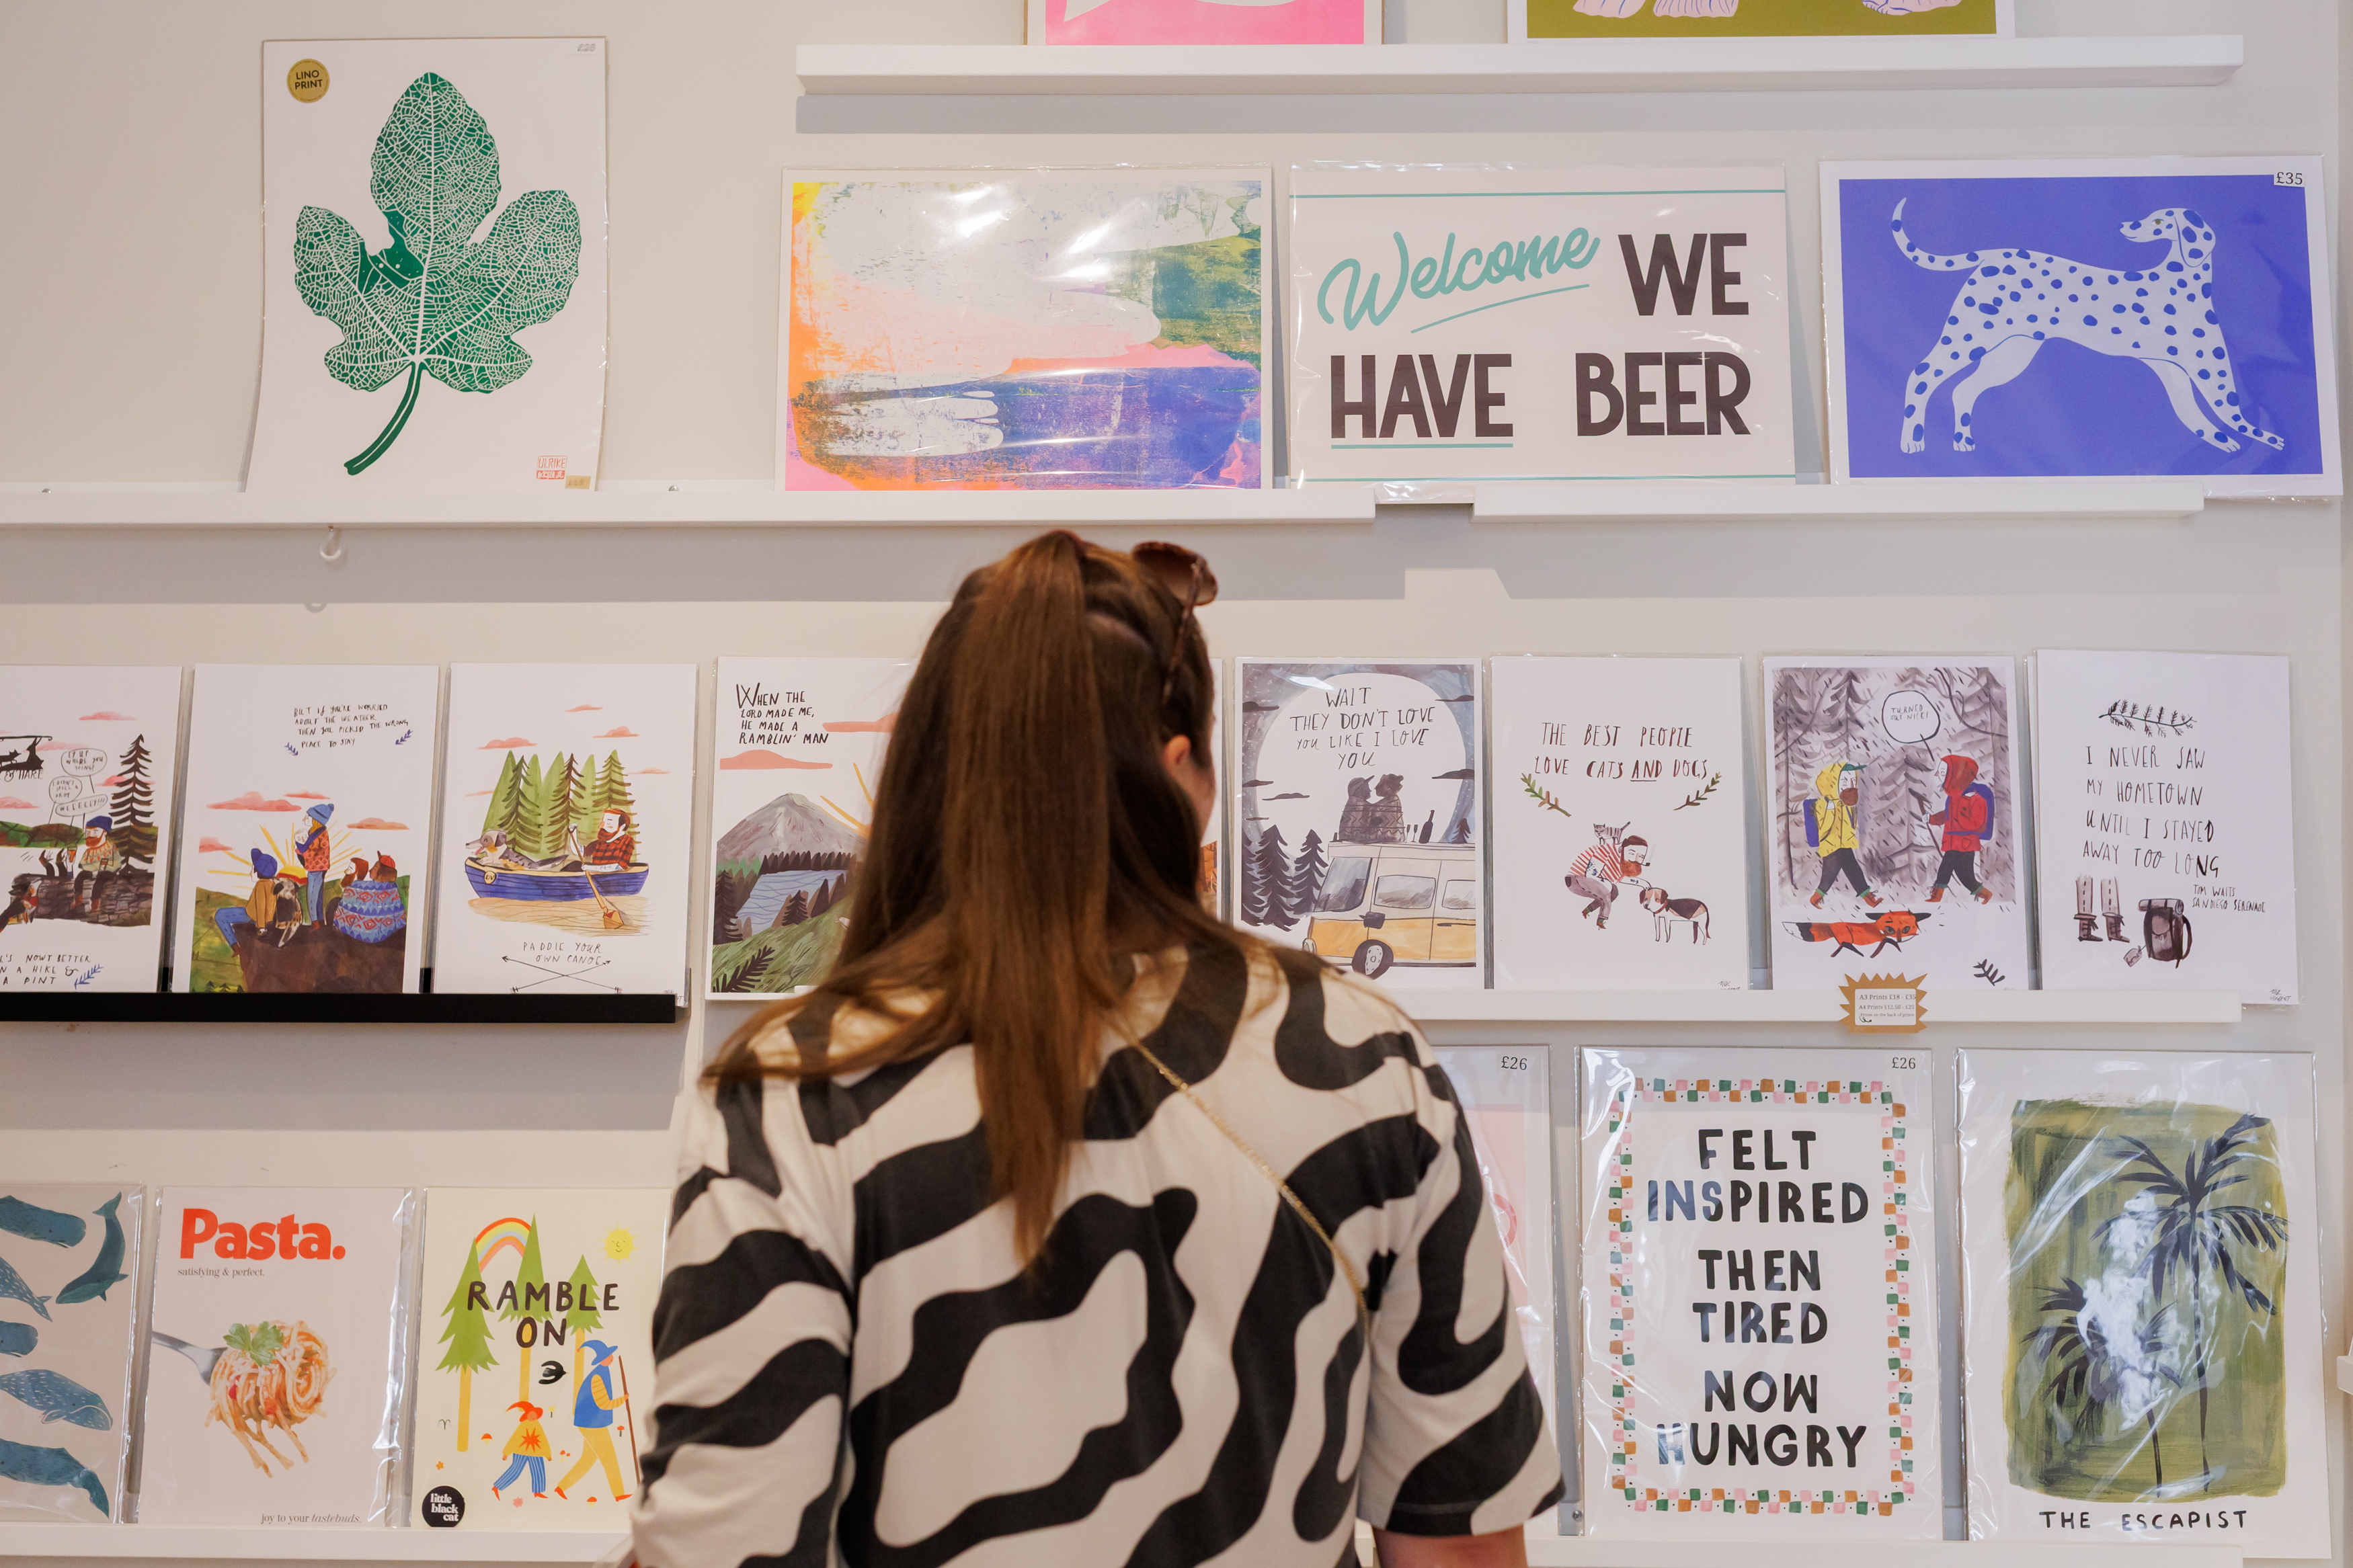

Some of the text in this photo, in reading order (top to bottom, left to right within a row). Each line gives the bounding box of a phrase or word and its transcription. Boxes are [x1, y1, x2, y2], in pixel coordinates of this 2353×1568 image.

[296, 70, 319, 79] LINO
[295, 79, 323, 90] PRINT
[2276, 171, 2303, 185] £35
[1317, 228, 1749, 331] Welcome WE
[1330, 352, 1751, 438] HAVE BEER
[539, 458, 565, 468] ULRIKE
[786, 691, 805, 703] THE
[1326, 687, 1371, 707] WAIT
[294, 707, 311, 717] BUT
[741, 707, 814, 718] LORD MADE ME,
[1890, 704, 1923, 714] TURNED
[742, 720, 797, 731] HE MADE A
[1290, 706, 1435, 731] THEY DON'T LOVE
[739, 732, 829, 745] RAMBLIN' MAN
[1297, 729, 1429, 750] YOU LIKE I LOVE
[1542, 722, 1692, 747] THE BEST PEOPLE
[340, 738, 355, 746] STAY
[1339, 751, 1375, 770] YOU
[2086, 745, 2205, 770] I NEVER SAW
[17, 768, 43, 780] HARE
[1534, 756, 1707, 780] LOVE CATS AND DOGS
[2087, 778, 2202, 805] MY HOMETOWN
[2087, 810, 2214, 843] UNTIL I STAYED
[2083, 839, 2219, 878] AWAY TOO LONG
[2194, 884, 2235, 897] TOM WAITS
[2234, 899, 2266, 913] SERENADE
[523, 942, 602, 954] PADDLE YOUR
[26, 954, 52, 963] NOWT
[56, 954, 91, 962] BETTER
[536, 954, 602, 964] OWN CANOE
[32, 965, 56, 974] HIKE
[3, 977, 56, 985] A PINT
[1501, 1056, 1527, 1070] £26
[1892, 1057, 1915, 1069] £26
[1698, 1129, 1816, 1170] FELT
[1648, 1180, 1869, 1223] INSPIRED
[180, 1208, 346, 1260] Pasta.
[177, 1268, 265, 1278] satisfying & perfect.
[1698, 1249, 1821, 1291] THEN
[467, 1280, 620, 1312] RAMBLE
[1692, 1301, 1828, 1344] TIRED
[516, 1317, 567, 1348] ON
[1704, 1370, 1818, 1413] NOW
[1657, 1422, 1867, 1467] HUNGRY
[430, 1493, 452, 1503] little
[431, 1503, 458, 1514] black
[261, 1514, 362, 1524] joy to your tastebuds.
[443, 1514, 459, 1522] cat
[2039, 1510, 2247, 1532] THE ESCAPIST
